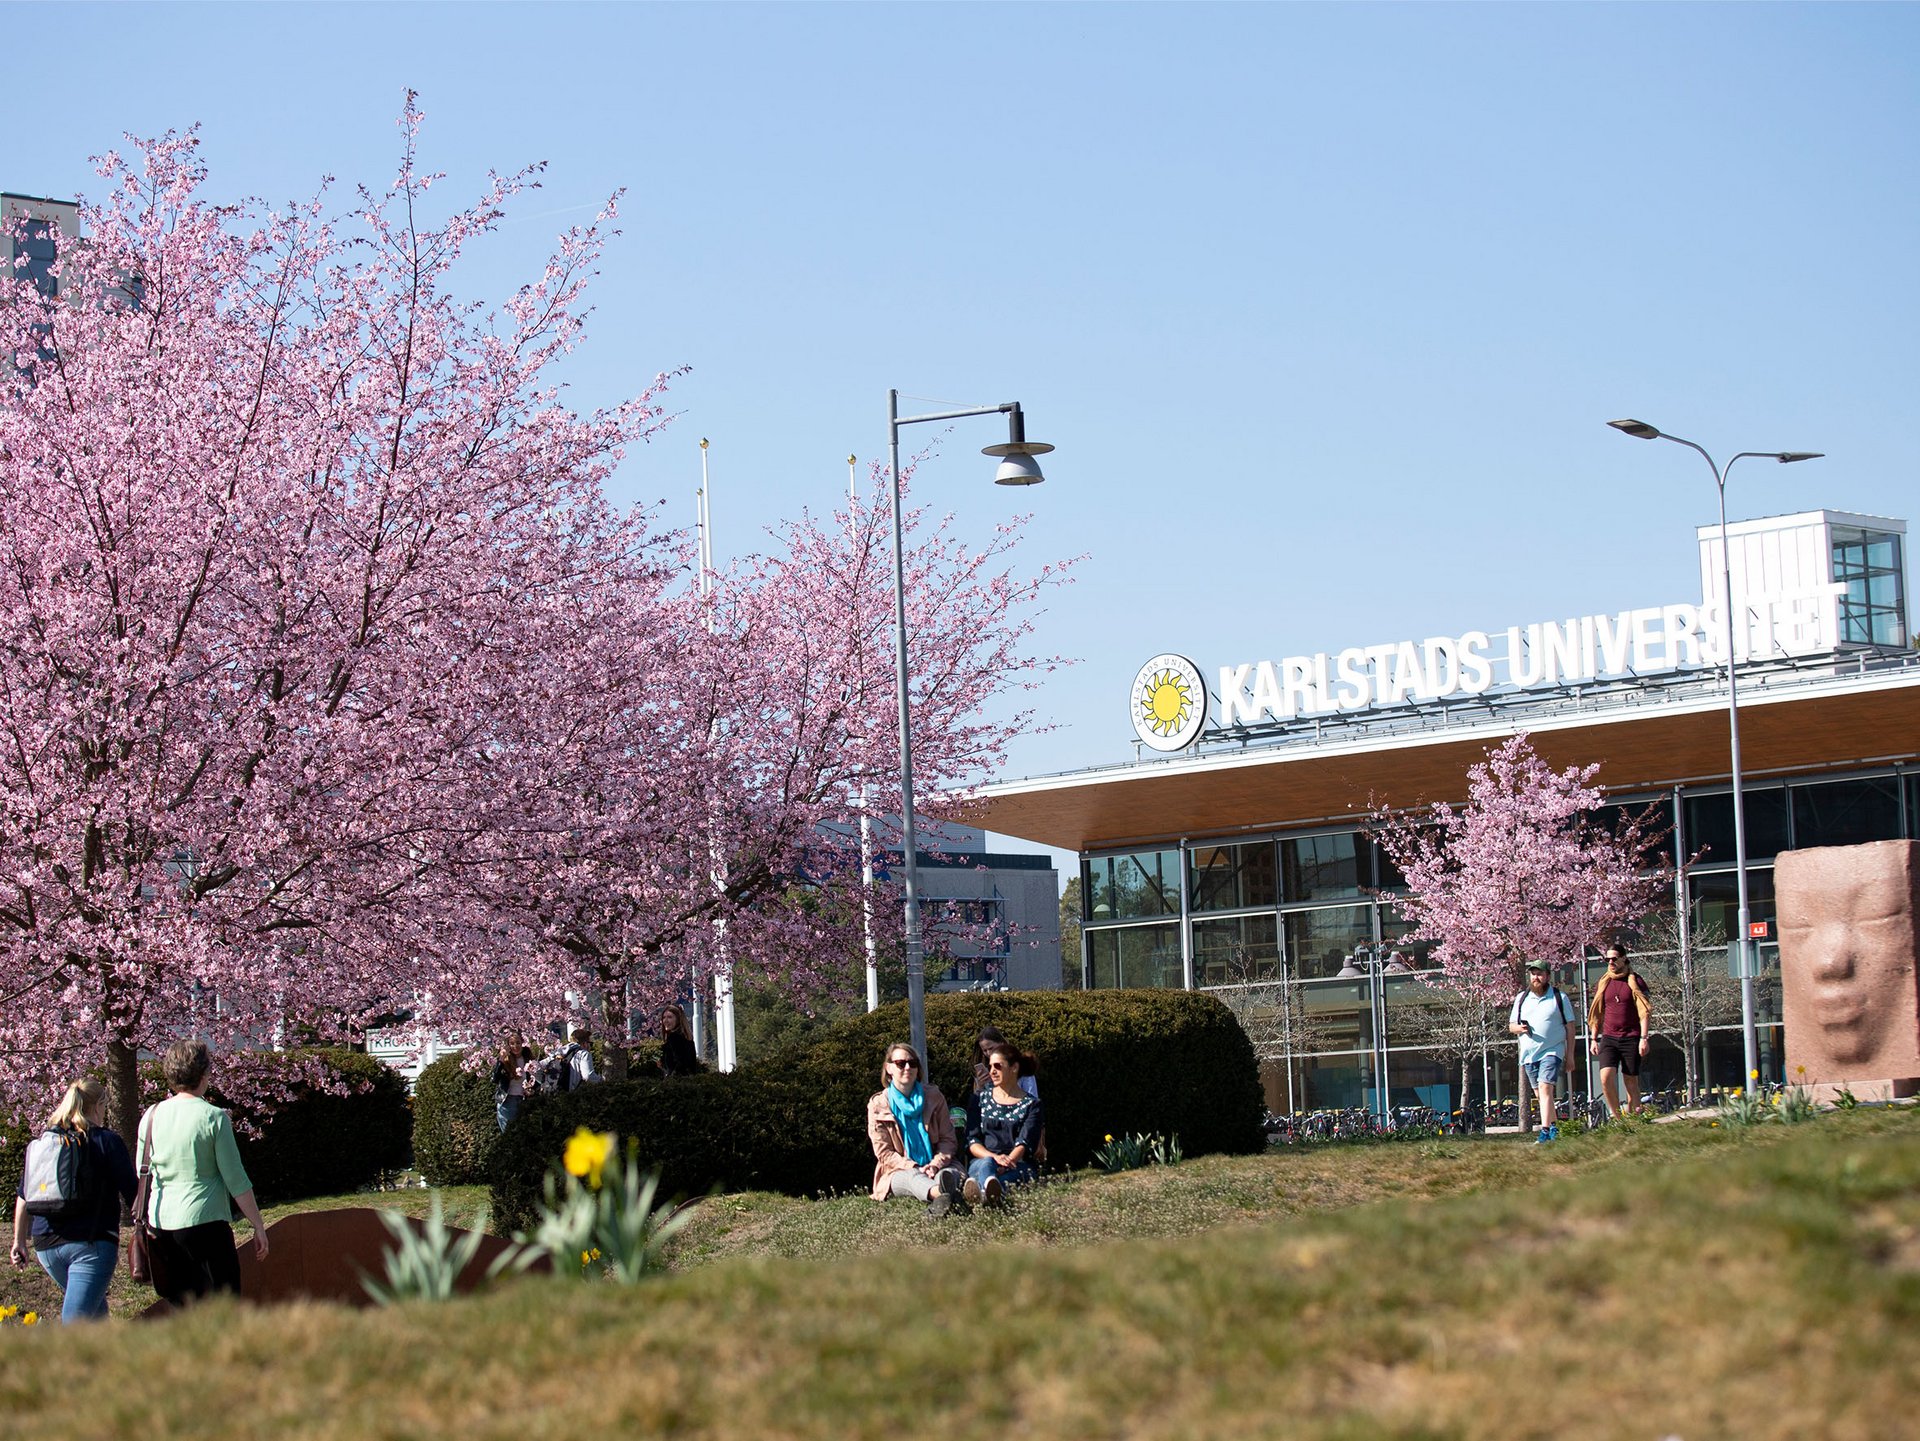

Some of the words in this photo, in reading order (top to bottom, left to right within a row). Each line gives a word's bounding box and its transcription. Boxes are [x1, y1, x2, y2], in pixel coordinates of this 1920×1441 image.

[1133, 661, 1159, 726] KARLSTADS
[1163, 658, 1200, 720] UNIVERSITET
[1219, 631, 1495, 725] KARLSTADS
[1507, 581, 1848, 688] UNIVERSITET
